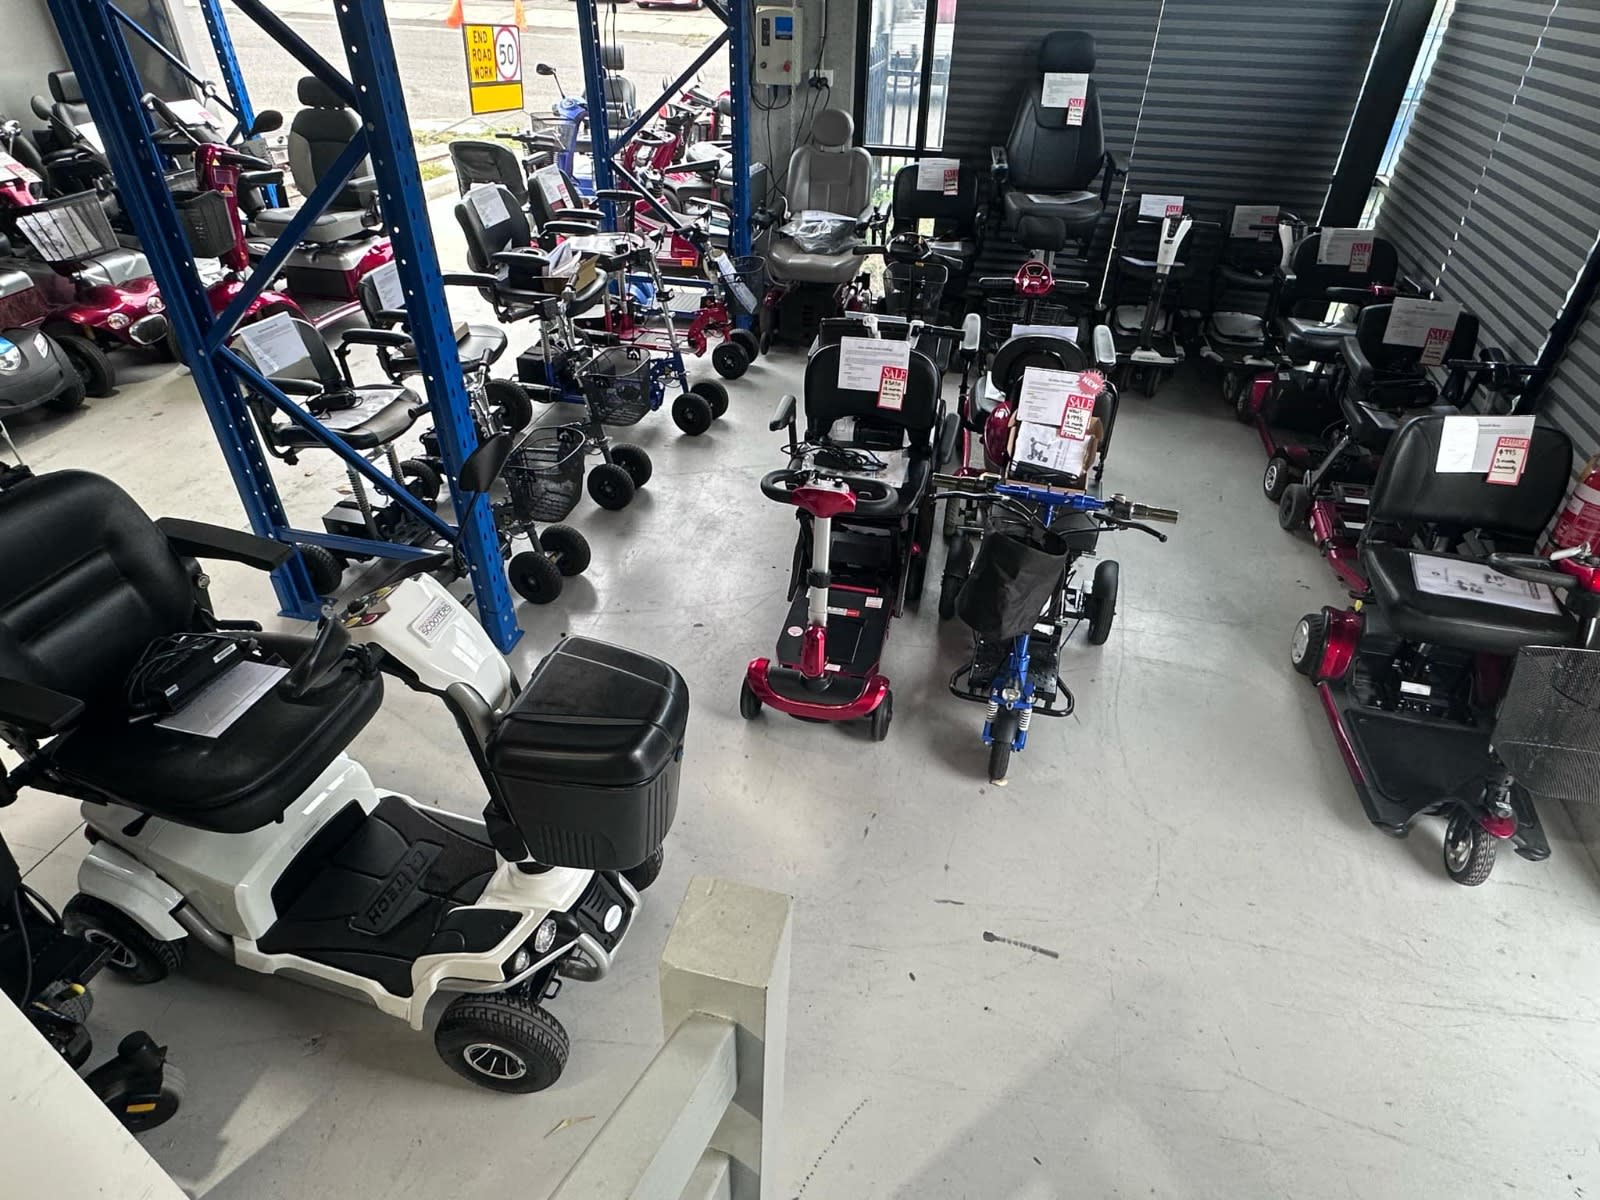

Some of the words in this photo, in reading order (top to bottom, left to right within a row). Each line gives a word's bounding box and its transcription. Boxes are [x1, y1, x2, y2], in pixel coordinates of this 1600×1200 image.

[473, 30, 488, 43] END
[472, 48, 492, 61] ROAD
[499, 43, 514, 65] 50
[474, 66, 493, 79] WORK
[1069, 98, 1085, 107] SALE
[1167, 205, 1182, 213] SALE
[1352, 243, 1371, 252] SALE
[1430, 329, 1453, 341] SALE
[883, 367, 906, 379] SALE
[1081, 376, 1100, 390] NEW
[1068, 396, 1095, 409] SALE
[421, 604, 452, 636] SCOOTERS
